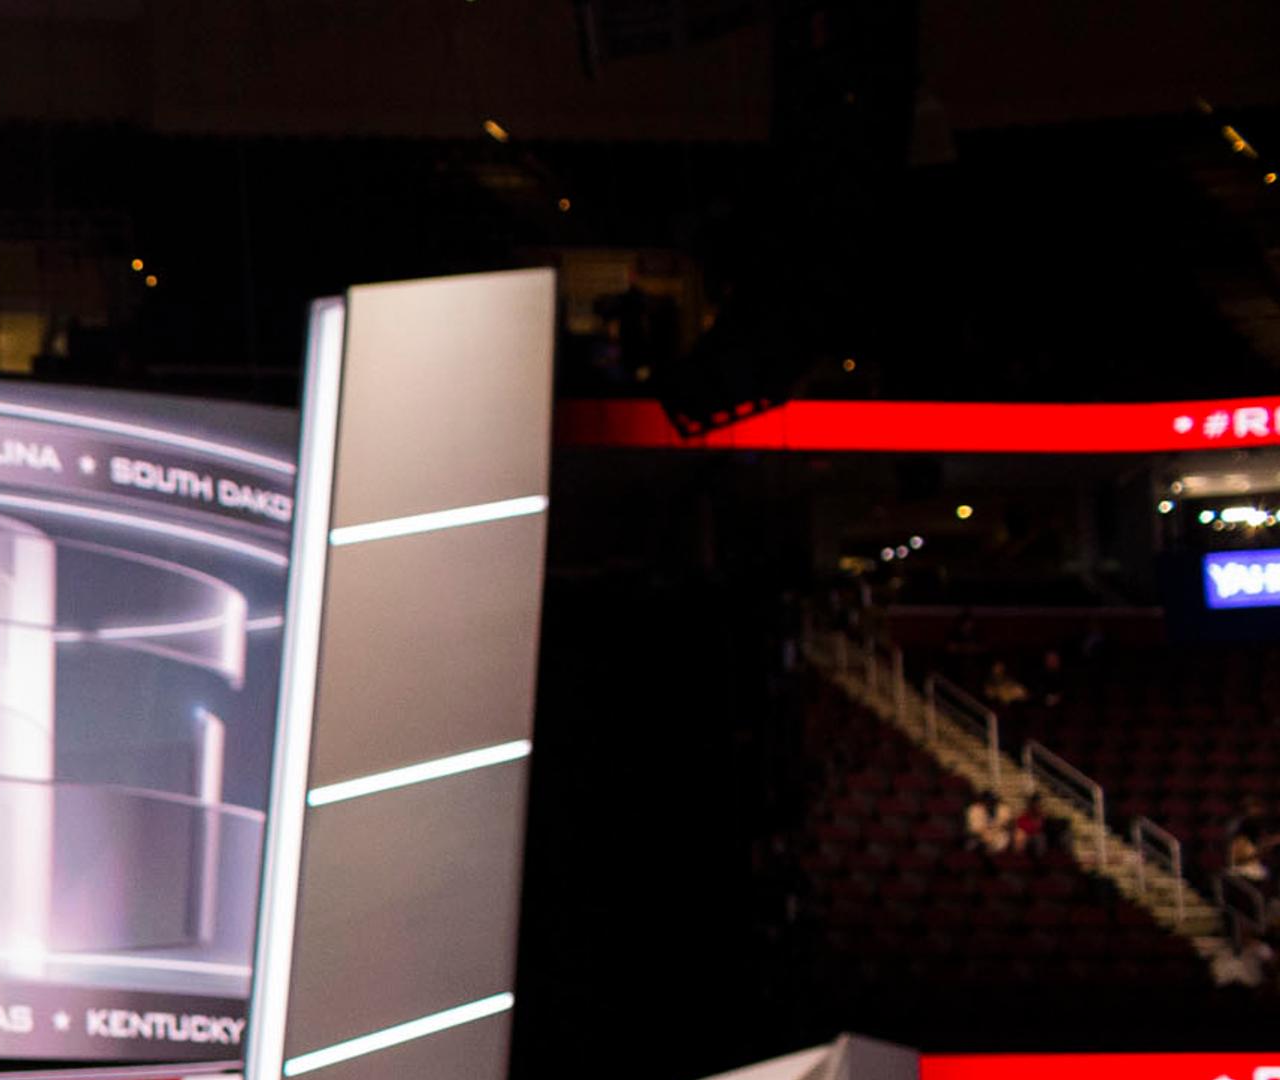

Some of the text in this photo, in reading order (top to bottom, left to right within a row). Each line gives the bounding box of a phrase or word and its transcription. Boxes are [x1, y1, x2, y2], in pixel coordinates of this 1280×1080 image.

[1203, 406, 1280, 438] #R
[109, 456, 213, 499] SOUTH
[85, 1007, 248, 1044] KENTUCKY
